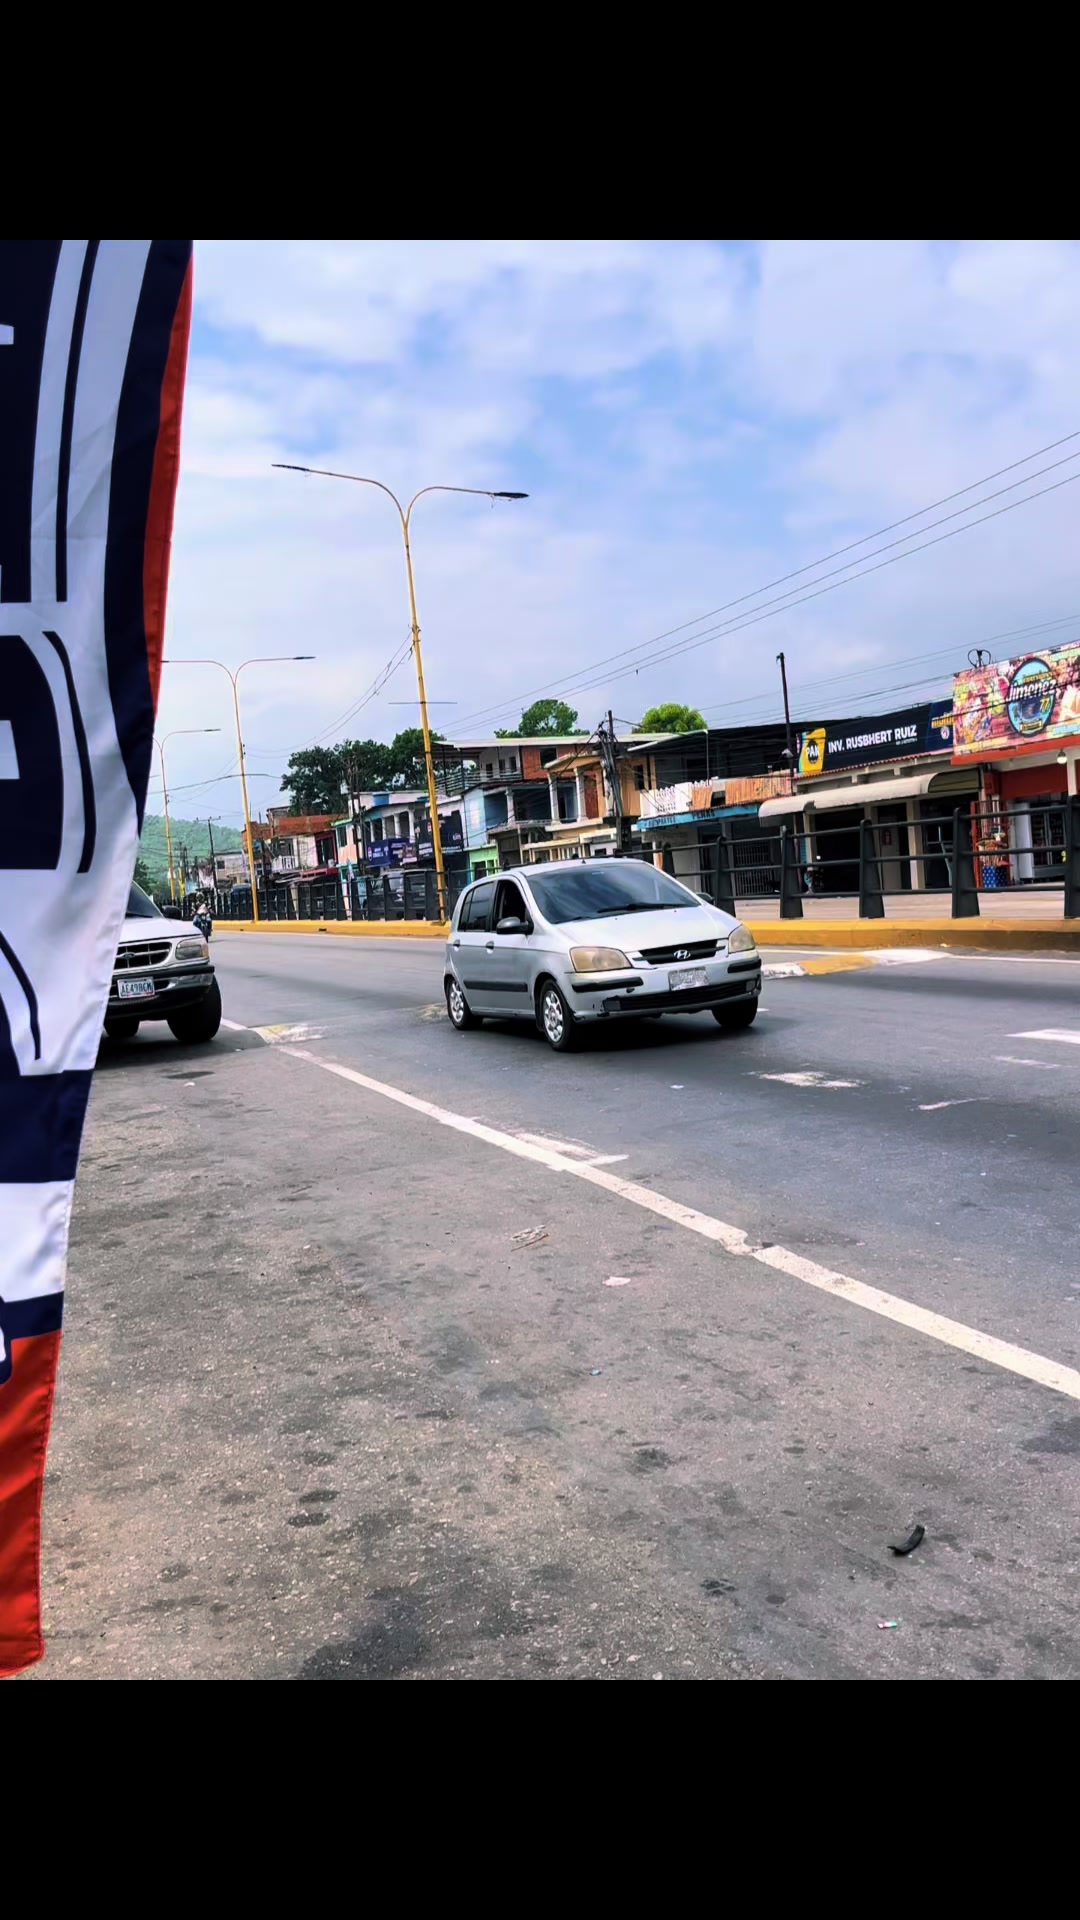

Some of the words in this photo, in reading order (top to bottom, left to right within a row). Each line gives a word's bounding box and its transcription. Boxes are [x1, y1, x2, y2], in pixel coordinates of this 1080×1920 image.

[828, 737, 845, 753] INV.
[846, 729, 893, 750] RUSBHERT
[895, 724, 917, 740] RUIZ
